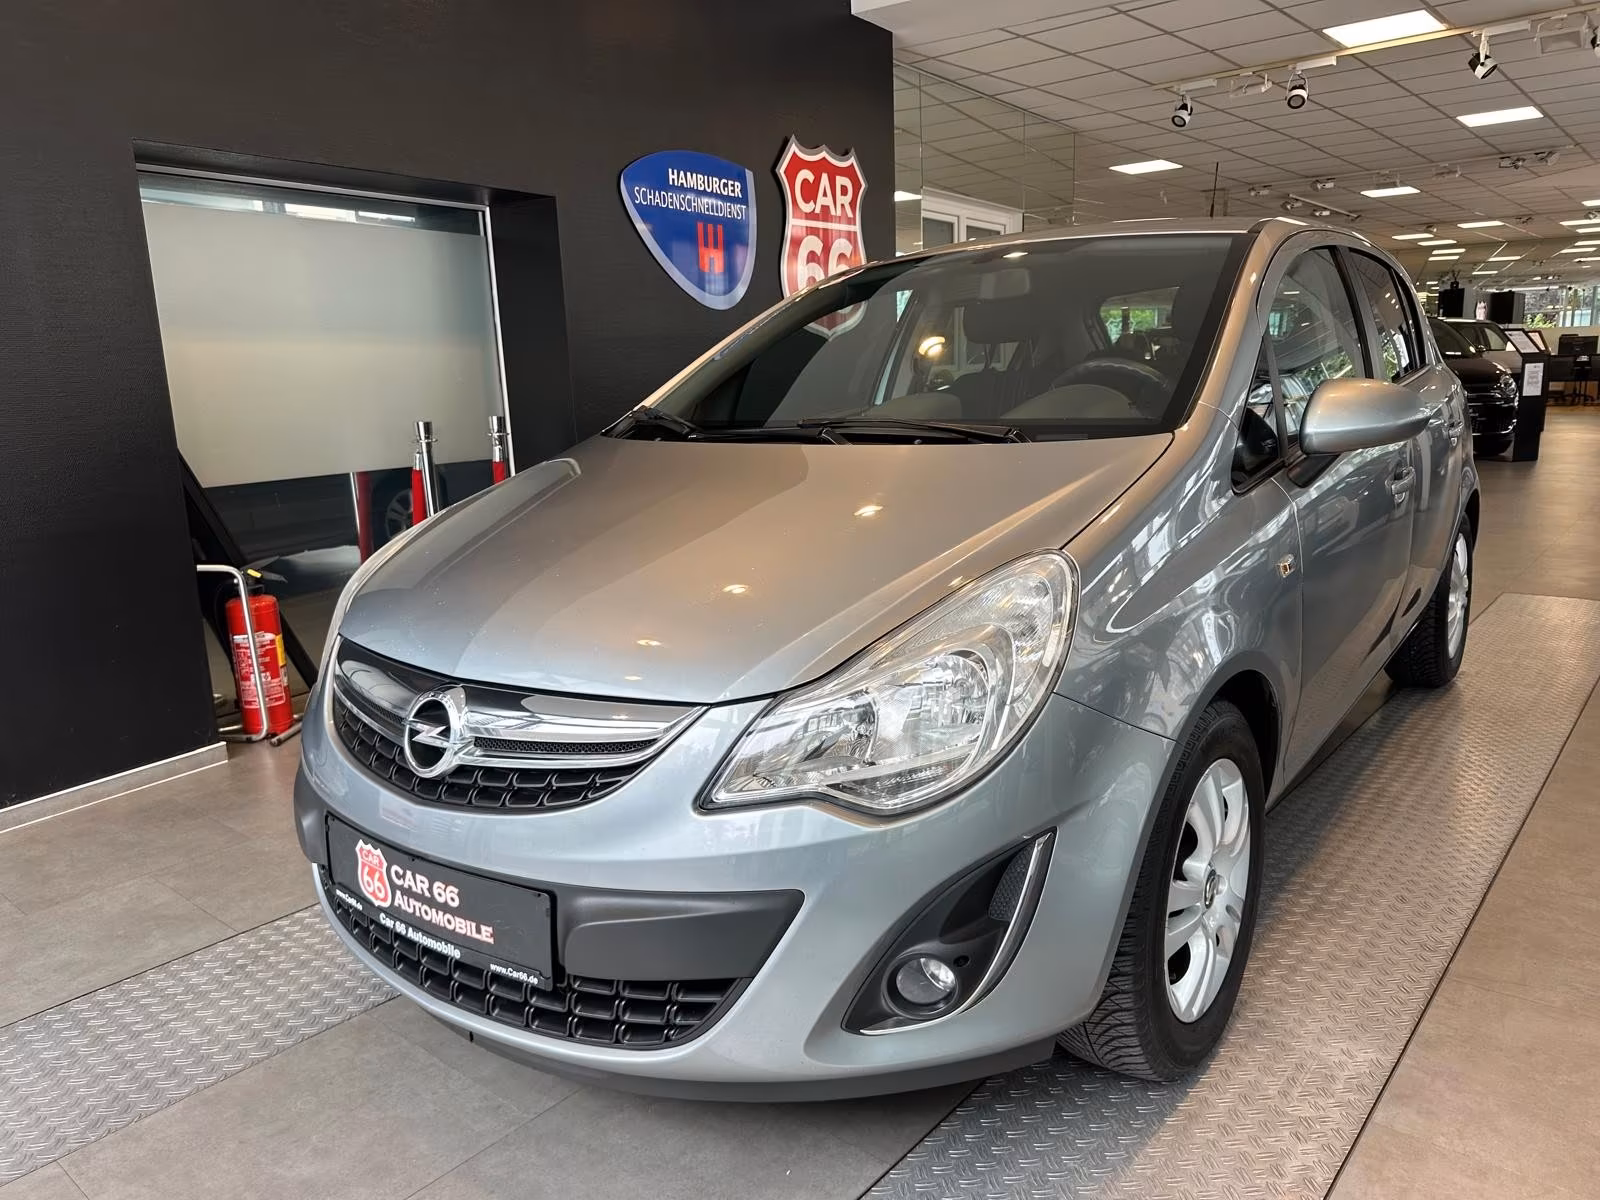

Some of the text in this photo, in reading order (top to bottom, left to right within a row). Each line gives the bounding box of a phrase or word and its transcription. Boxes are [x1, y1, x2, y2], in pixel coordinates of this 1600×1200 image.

[668, 168, 742, 198] HAMBURGER
[795, 168, 853, 218] CAR
[634, 186, 747, 220] SCHADENSCHNELLDIENST
[362, 850, 380, 867] CAR
[363, 865, 385, 899] 66
[390, 864, 460, 908] CAR 66
[394, 890, 495, 945] AUTOMOBILE
[379, 912, 461, 959] Car 66 Automobile
[490, 963, 539, 986] www.Car66.de
